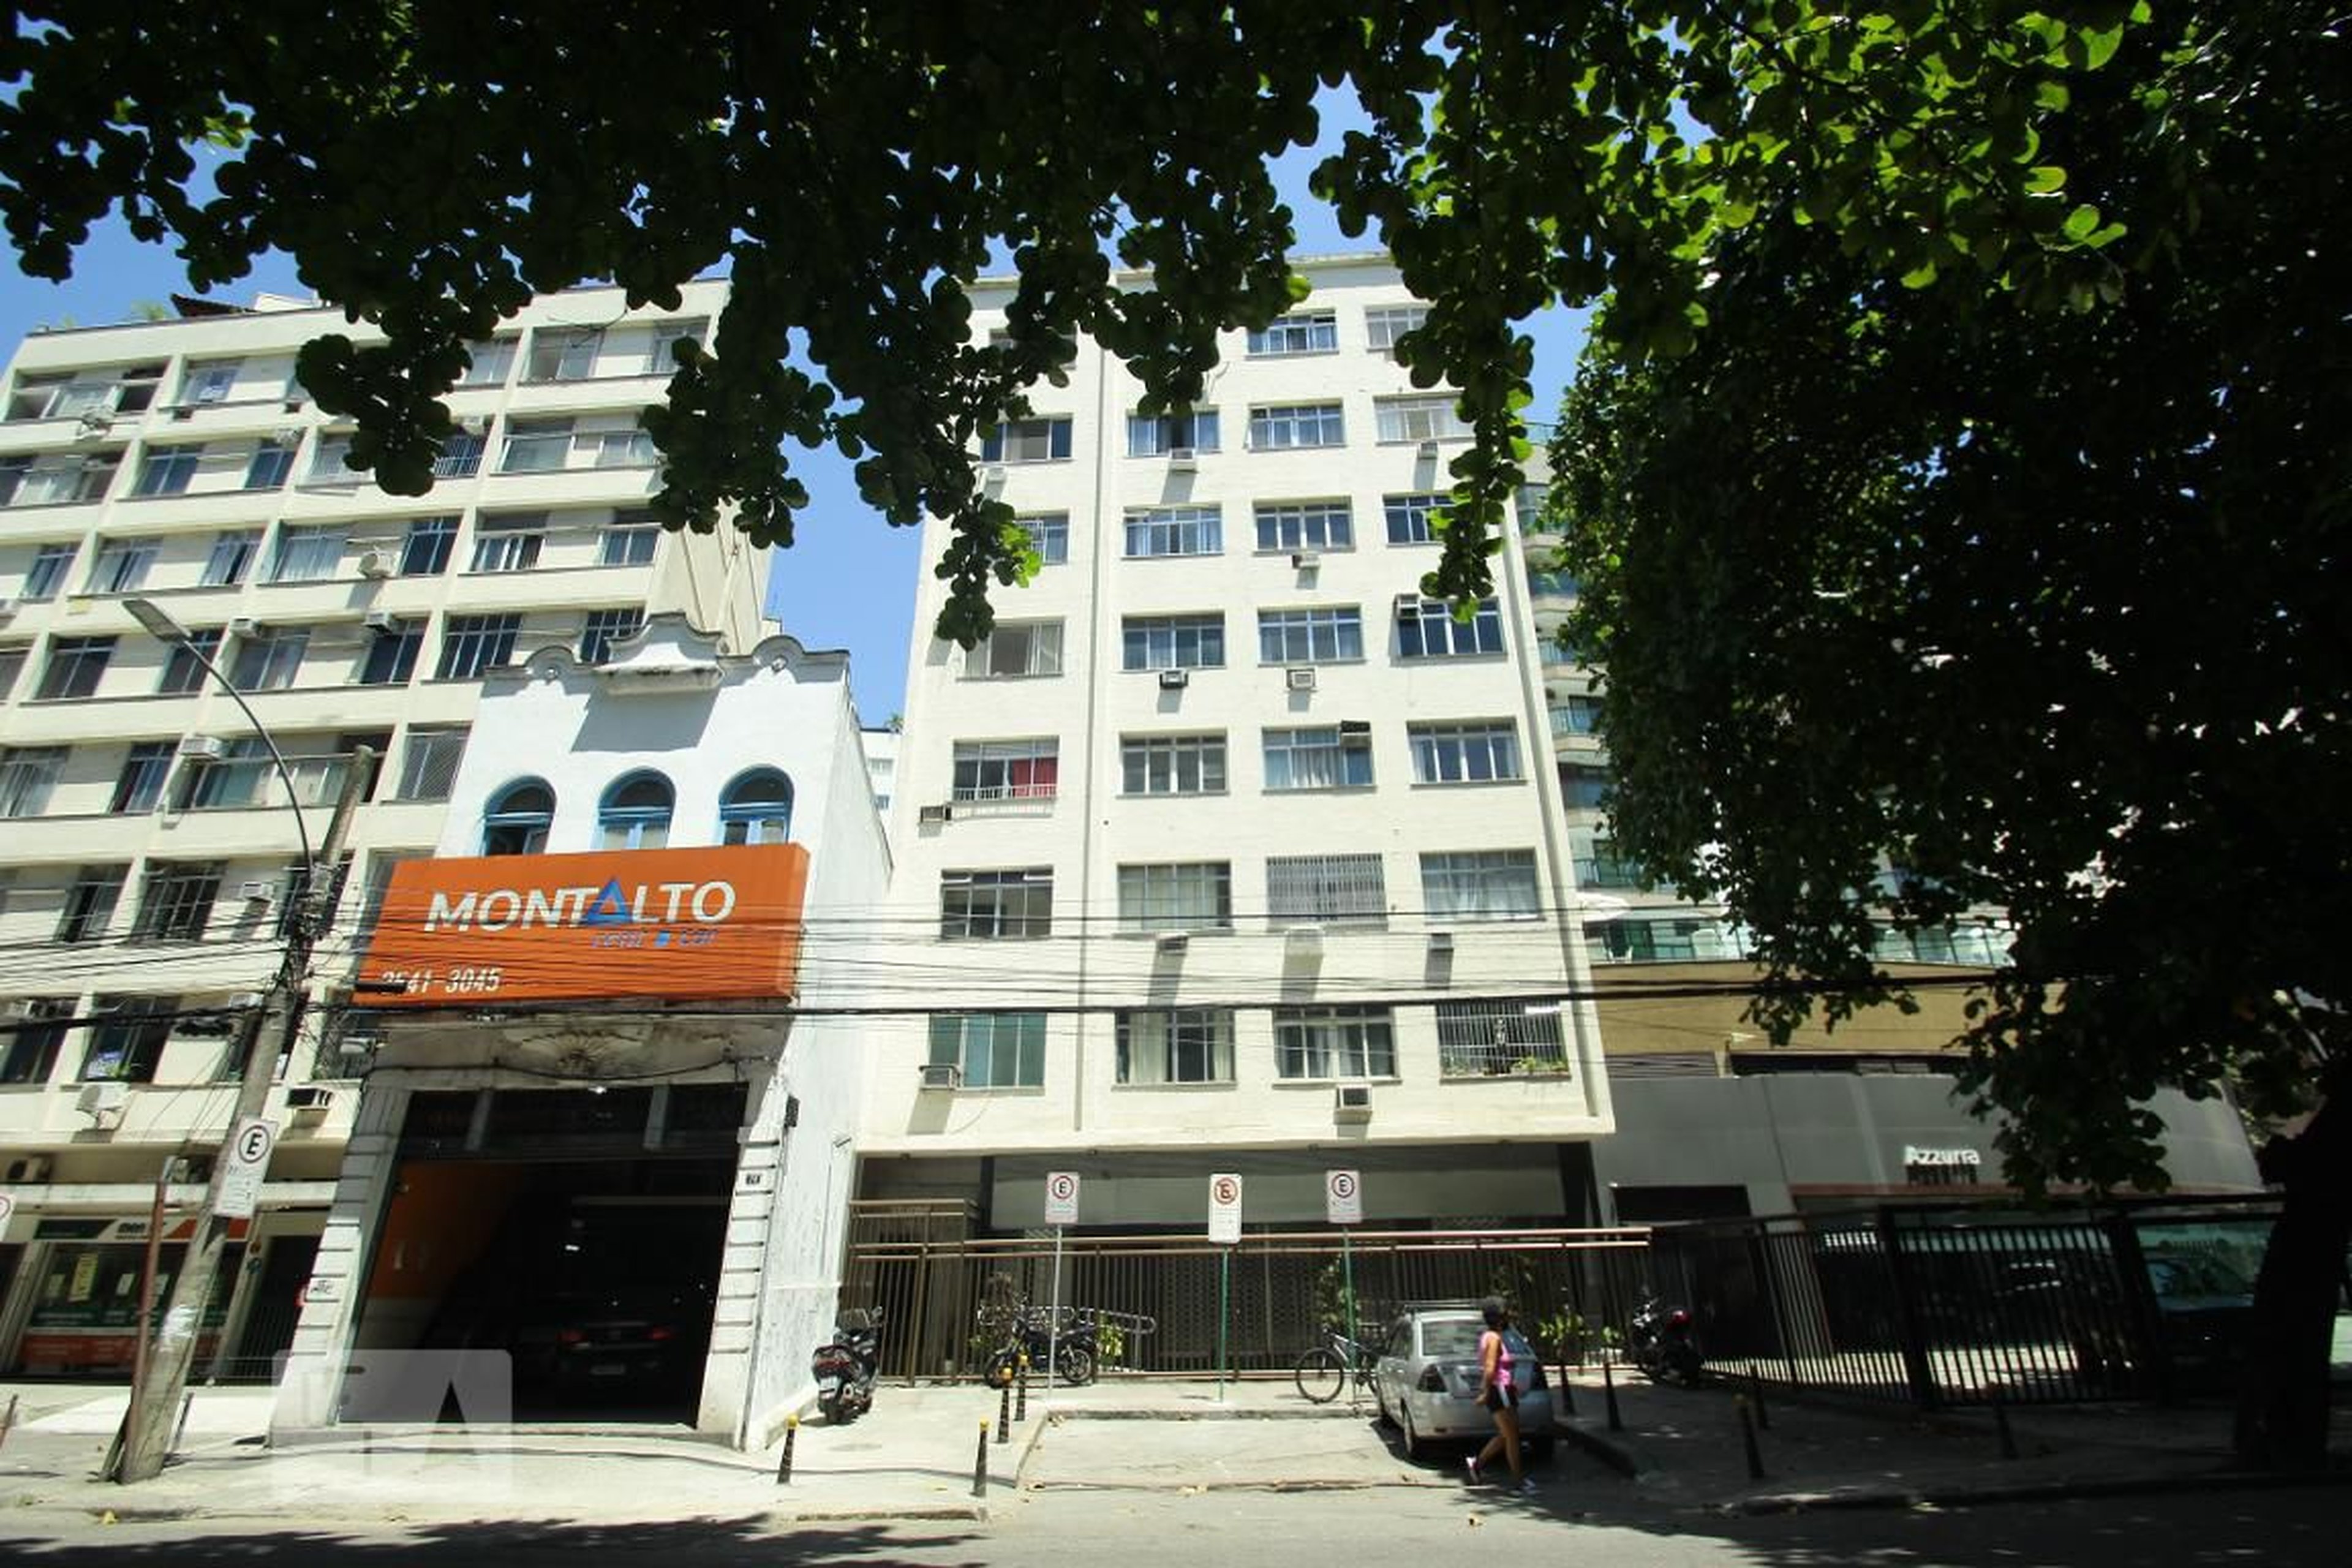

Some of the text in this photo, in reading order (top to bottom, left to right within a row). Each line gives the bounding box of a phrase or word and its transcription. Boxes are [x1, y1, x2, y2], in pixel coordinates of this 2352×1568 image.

[424, 876, 736, 932] MONTALTO
[246, 1133, 262, 1155] E
[1059, 1180, 1067, 1194] E
[1339, 1179, 1348, 1193] E
